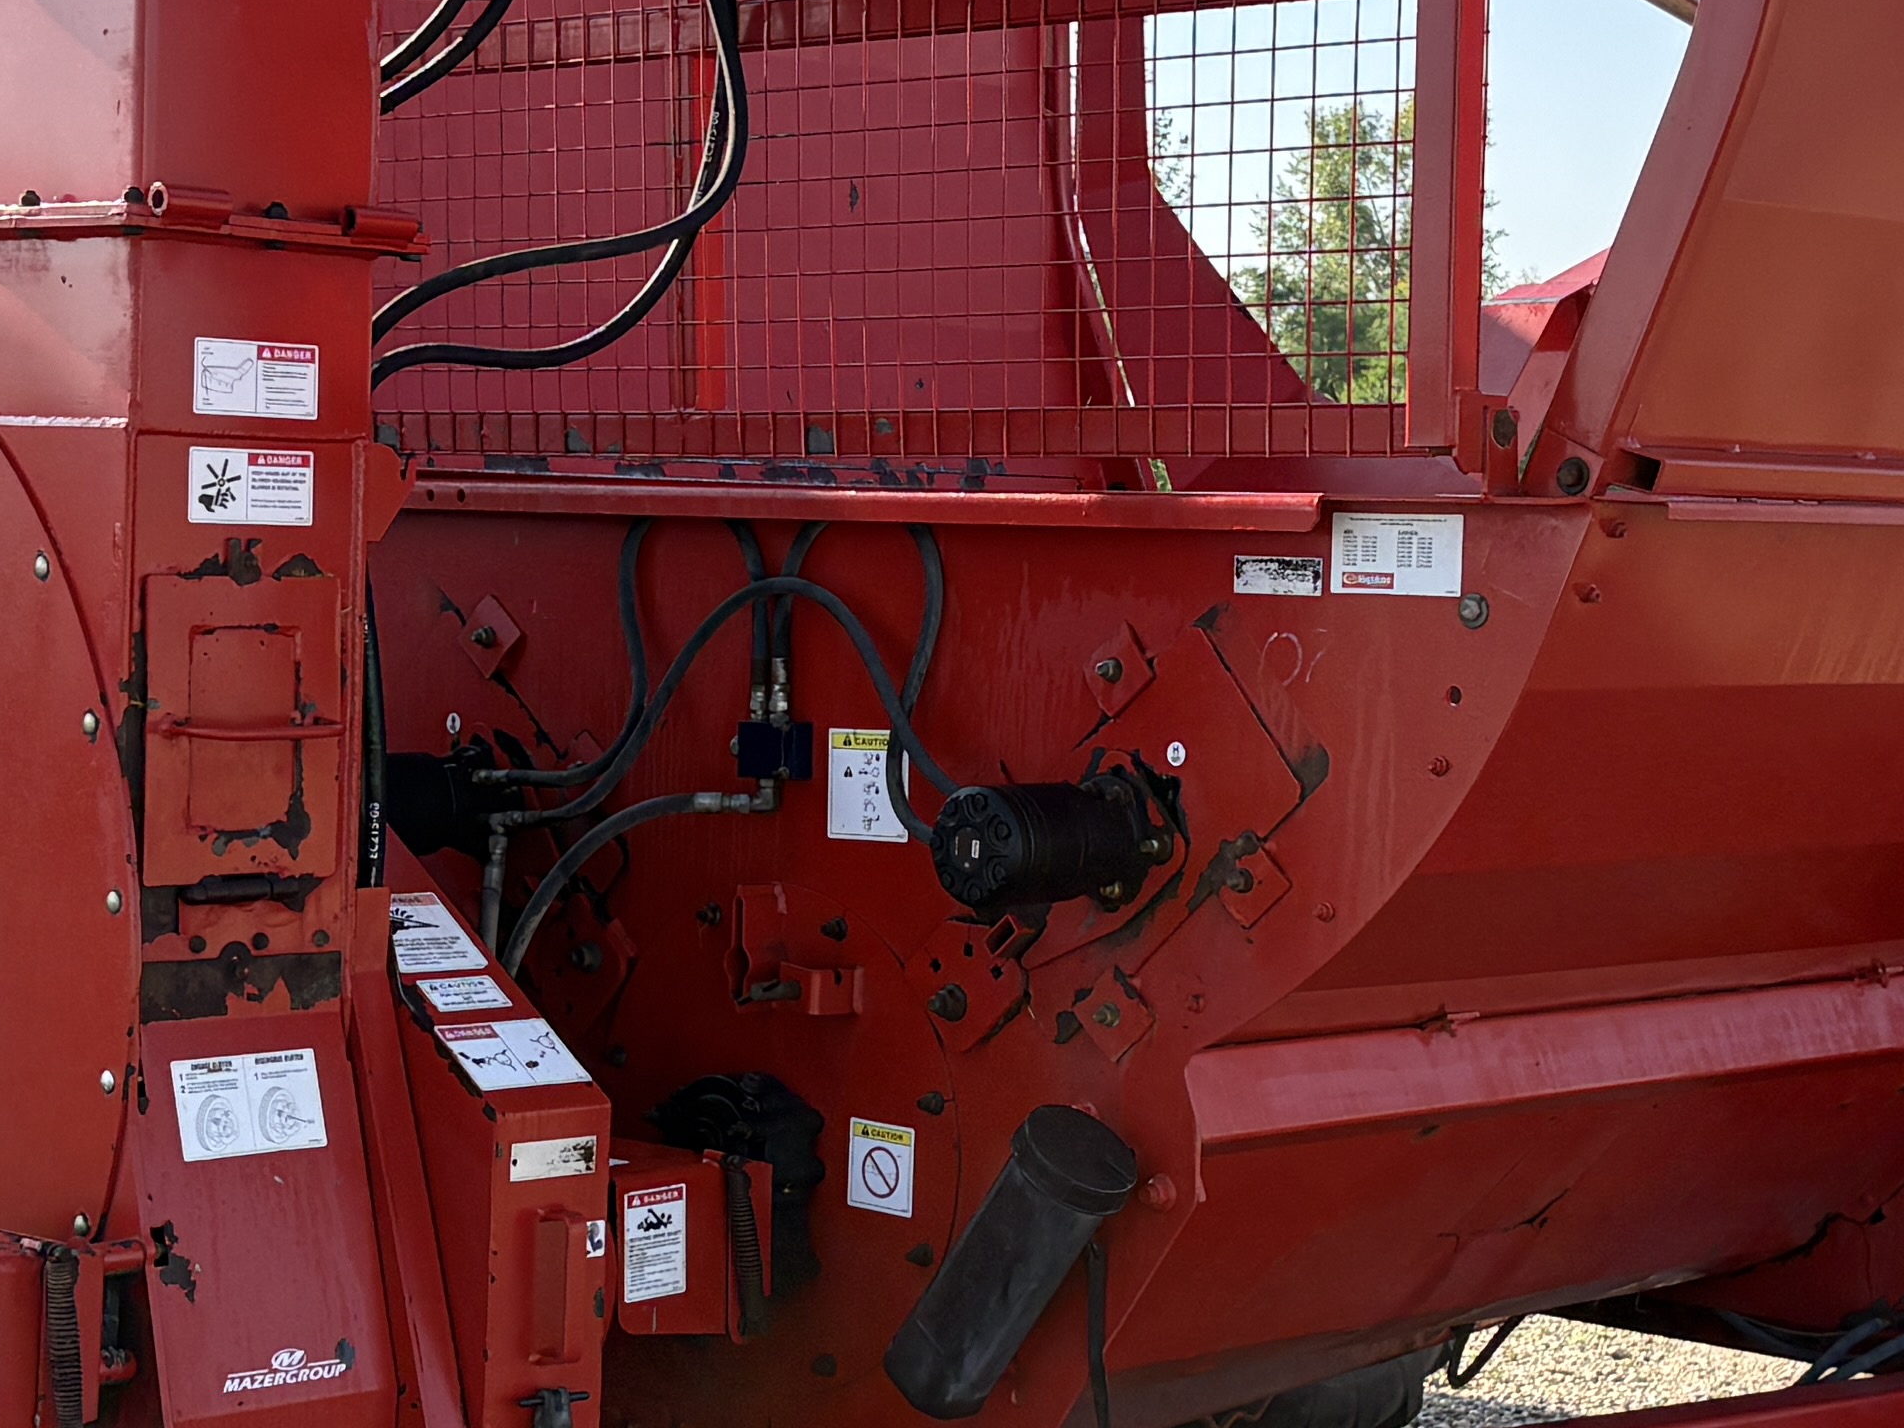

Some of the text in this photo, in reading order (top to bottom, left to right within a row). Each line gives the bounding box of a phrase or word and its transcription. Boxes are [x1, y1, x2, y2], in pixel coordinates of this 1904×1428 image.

[273, 347, 312, 360] DANGER
[266, 454, 303, 466] DANGER
[854, 737, 889, 747] CAUTIO
[223, 1363, 347, 1394] MAZERGROUP
